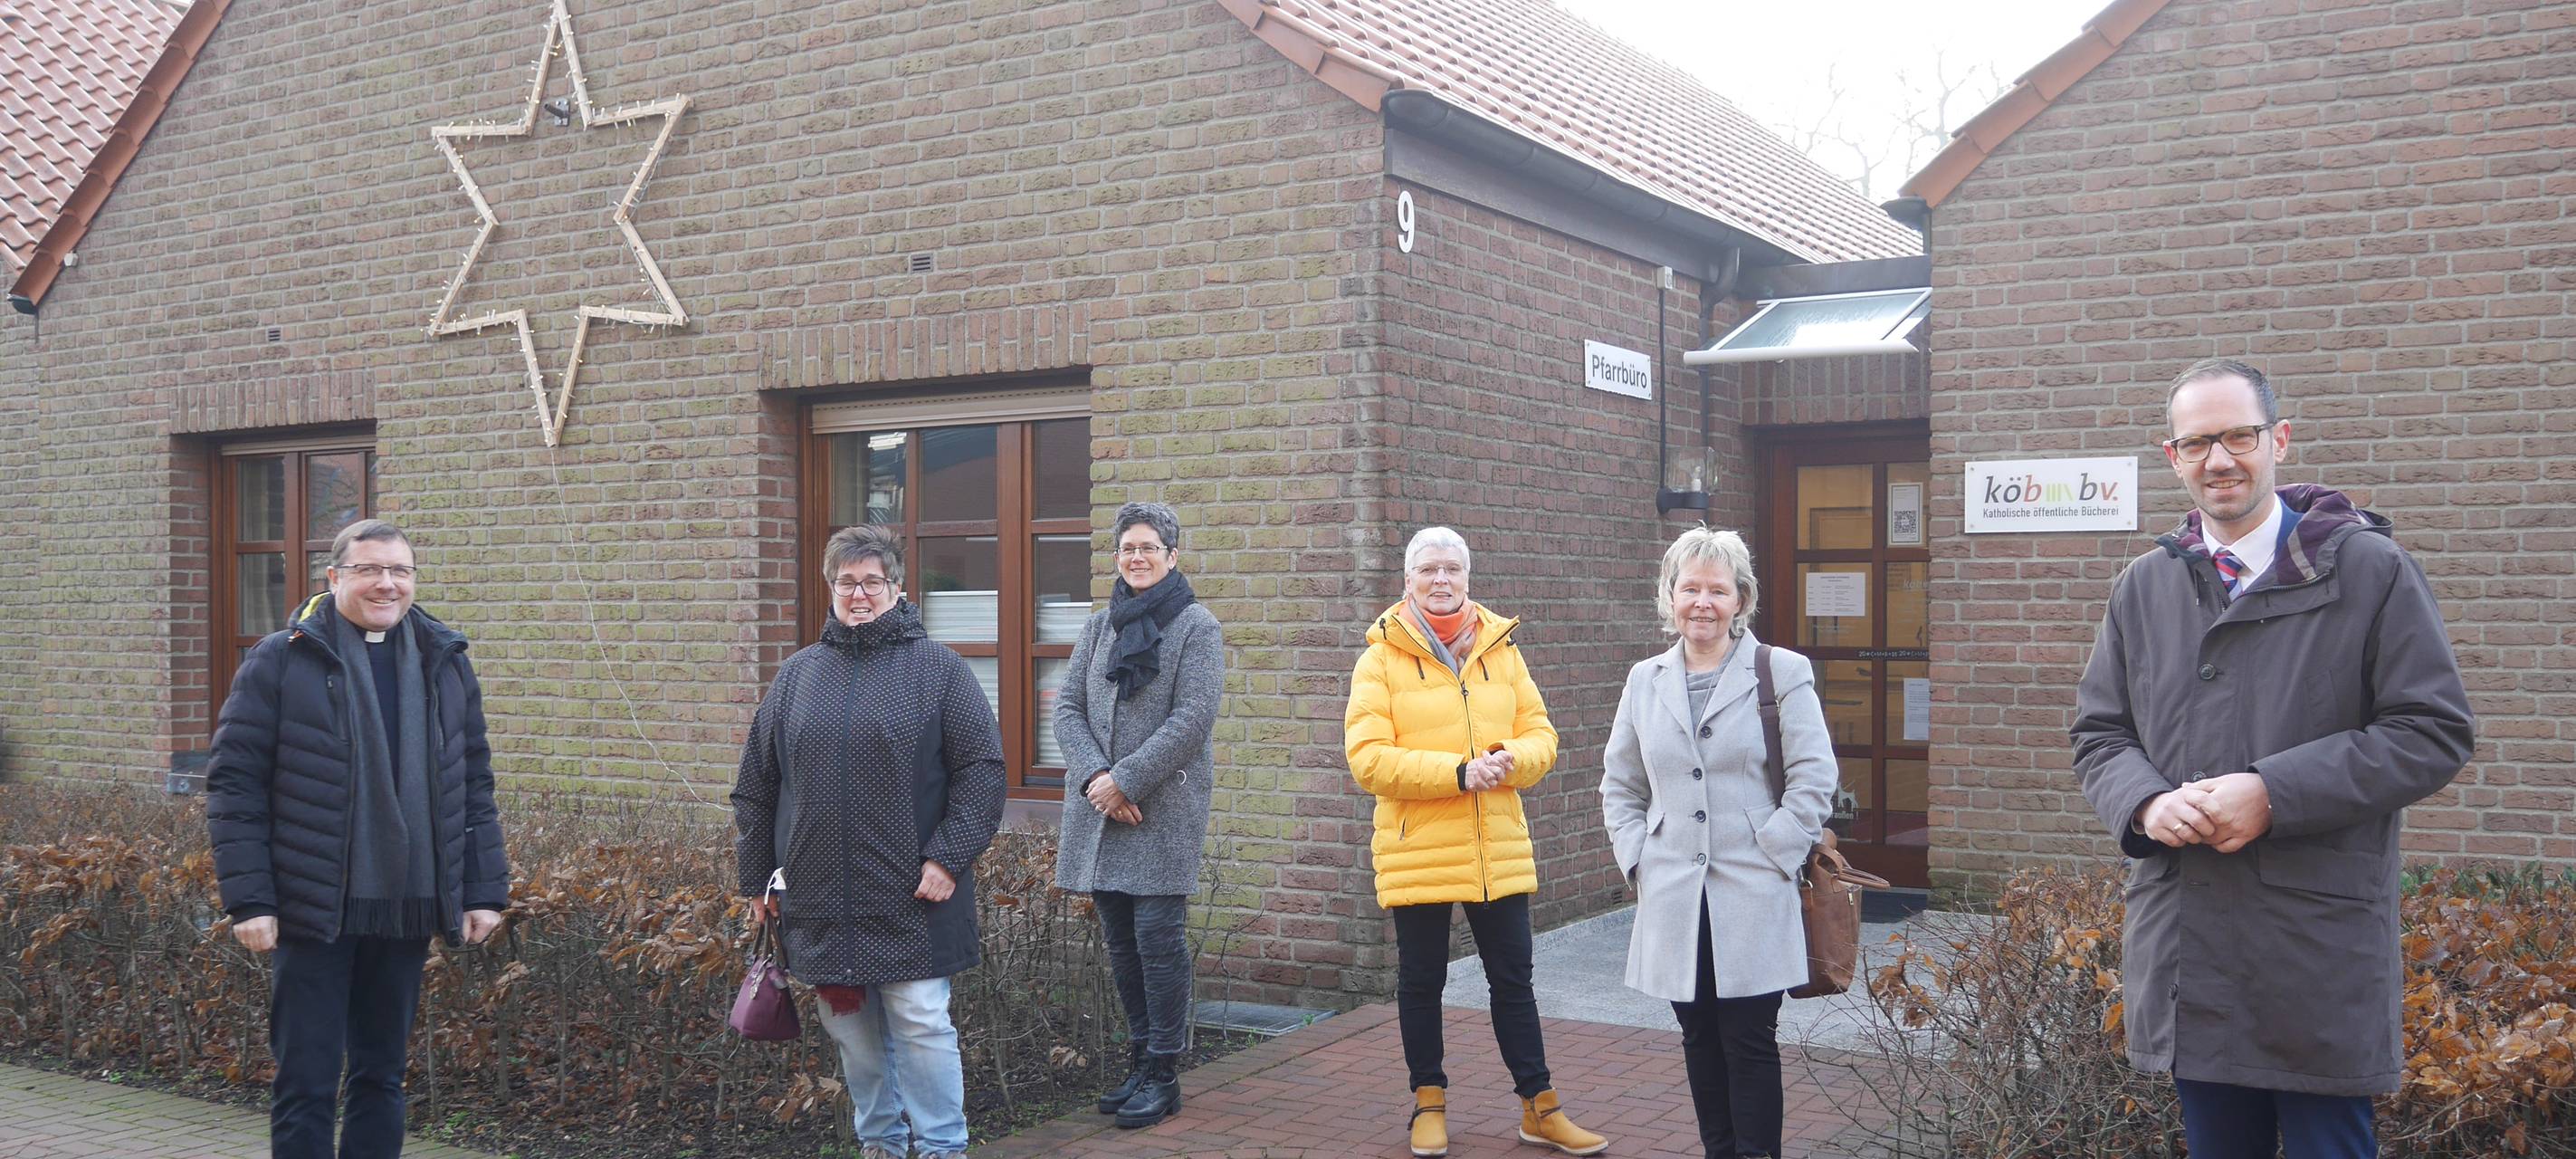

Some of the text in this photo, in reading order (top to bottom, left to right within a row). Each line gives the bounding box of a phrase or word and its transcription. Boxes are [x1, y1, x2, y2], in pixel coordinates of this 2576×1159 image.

[1398, 190, 1415, 253] 9
[1592, 354, 1647, 388] Pfarrbüro
[1984, 473, 2119, 503] köb bv.
[1983, 505, 2119, 519] Katholische öffentliche Bücherei
